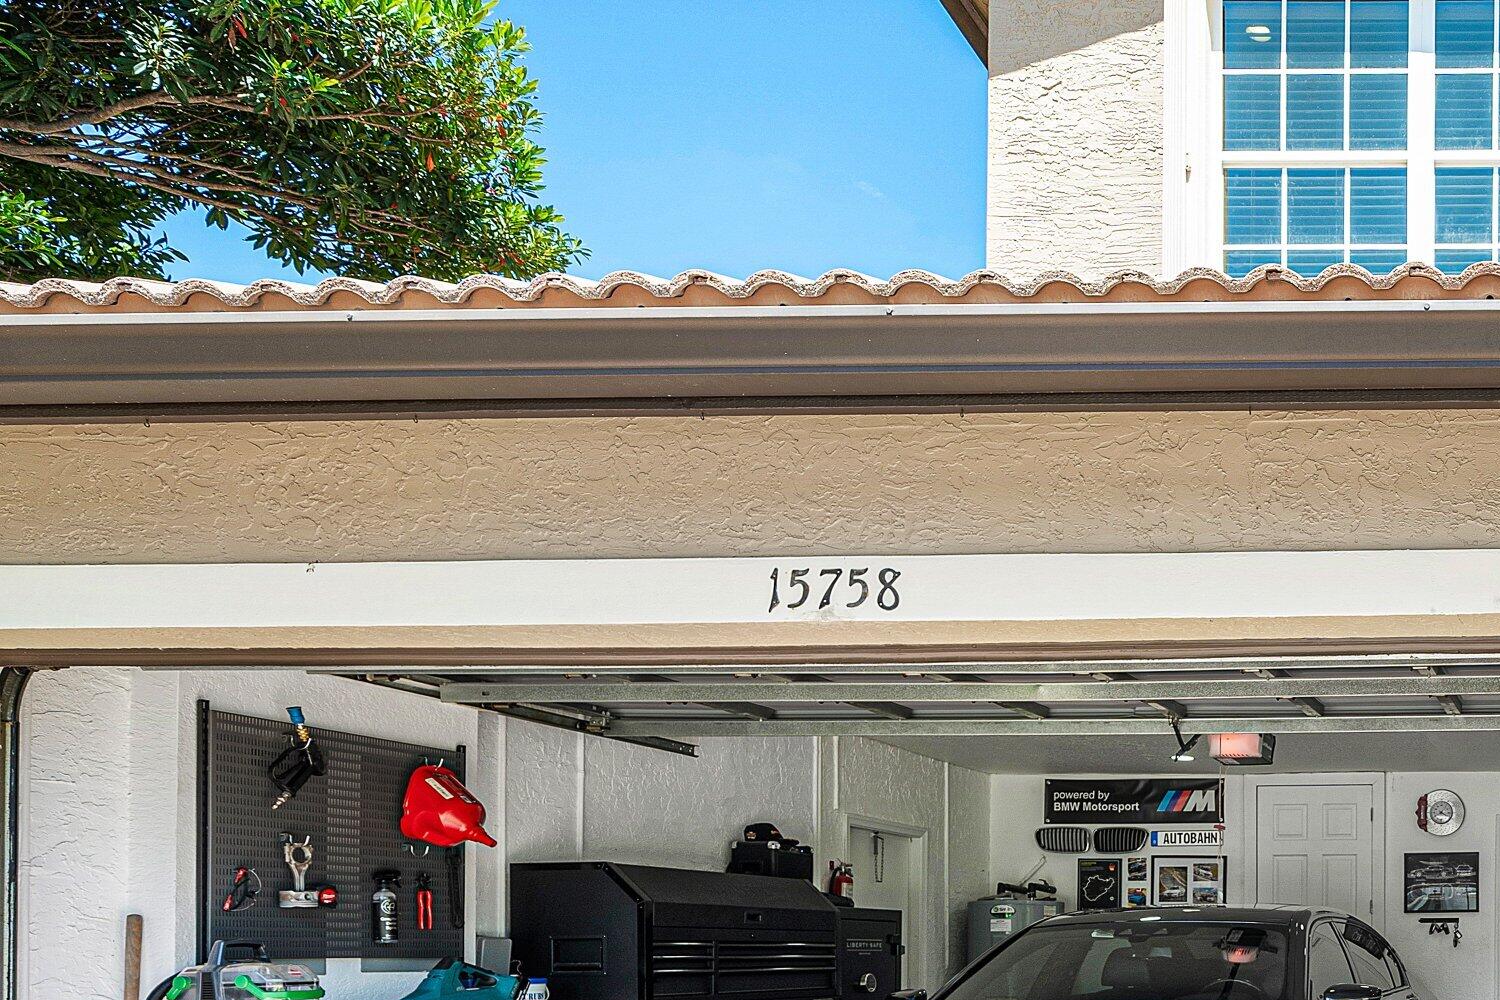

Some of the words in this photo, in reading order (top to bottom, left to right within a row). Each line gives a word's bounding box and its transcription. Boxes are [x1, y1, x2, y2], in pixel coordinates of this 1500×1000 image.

[768, 567, 902, 614] 15758
[1053, 790, 1096, 801] powered
[1097, 790, 1110, 801] by
[1053, 801, 1080, 811] BMW
[1082, 802, 1140, 813] Motorsport
[1163, 832, 1218, 844] AUTOBAHN
[527, 992, 545, 1000] RUBS
